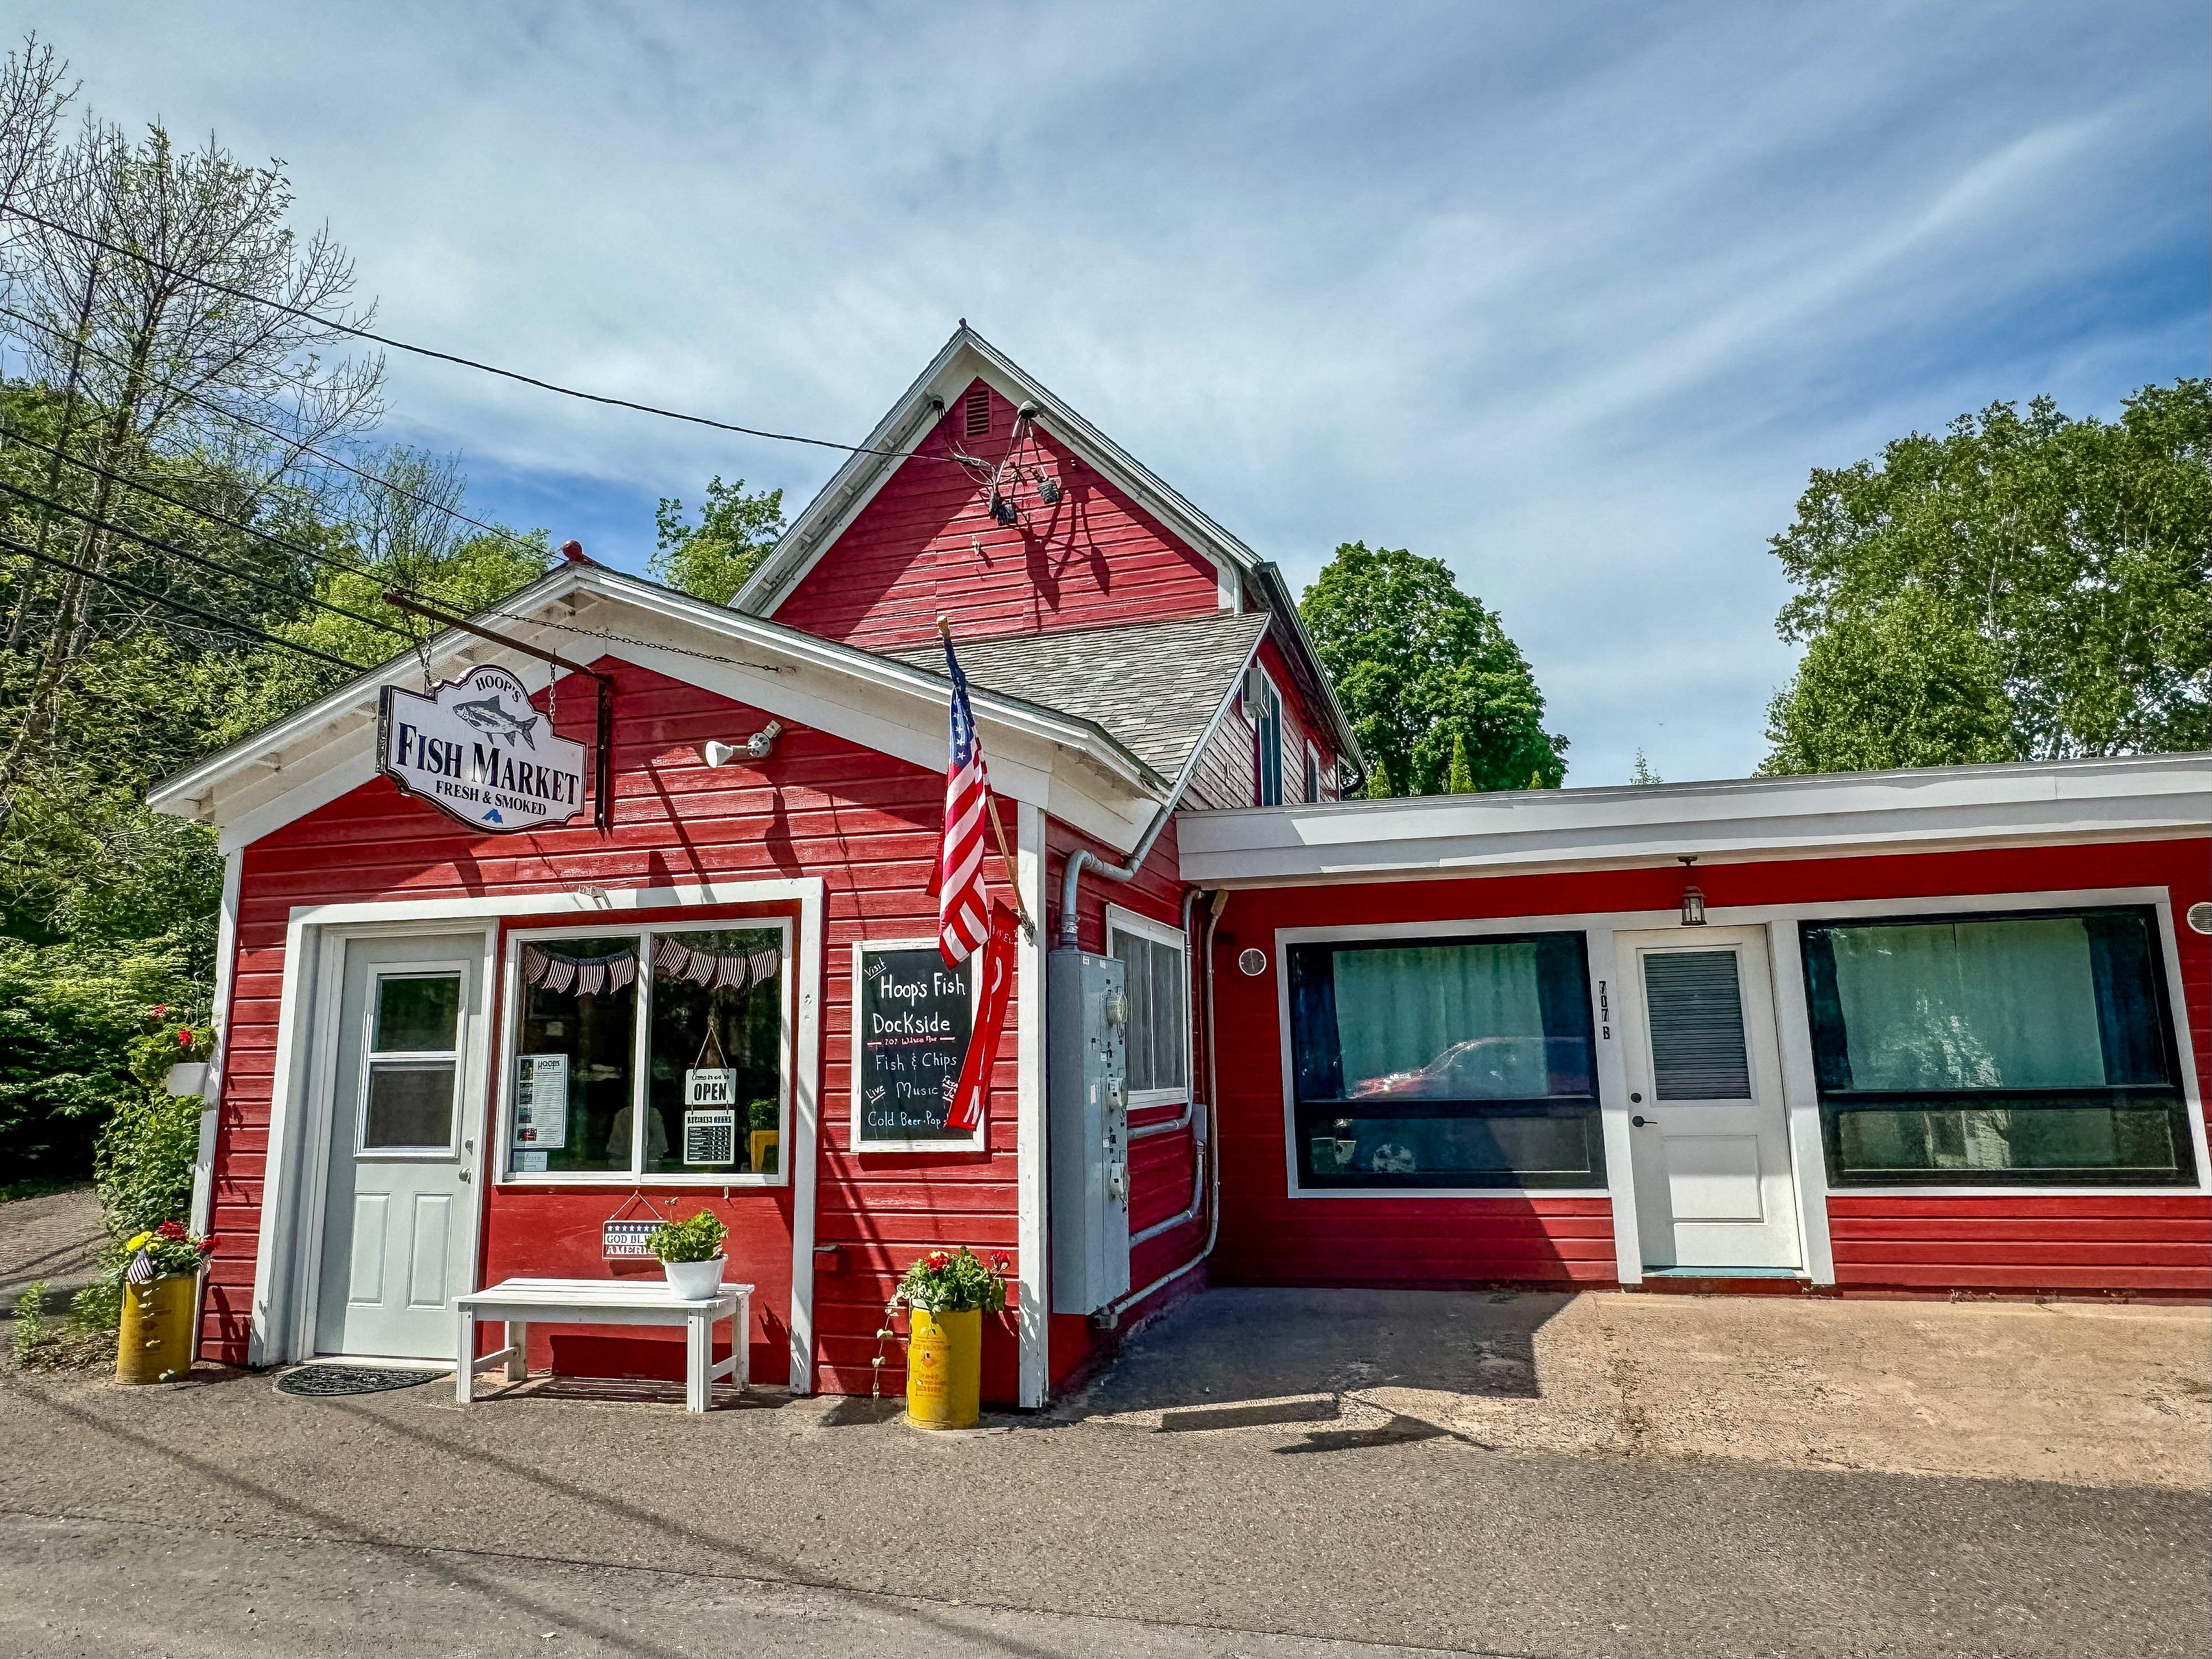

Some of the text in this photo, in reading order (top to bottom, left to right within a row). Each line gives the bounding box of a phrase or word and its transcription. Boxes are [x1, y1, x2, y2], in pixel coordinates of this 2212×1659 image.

[475, 676, 522, 703] HOOP'S
[396, 722, 579, 806] FISH MARKET
[436, 781, 547, 816] FRESH & SMOKED
[864, 957, 886, 977] Visit
[881, 972, 966, 1006] Hoop's Fish
[1598, 980, 1610, 1039] 707 B
[873, 1011, 950, 1034] Dockside
[876, 1054, 905, 1071] Fish
[922, 1053, 957, 1074] Chips
[694, 1082, 728, 1101] OPEN
[866, 1085, 886, 1099] Live
[896, 1082, 939, 1098] Music
[868, 1110, 895, 1127] Cold
[607, 1235, 628, 1244] GOD
